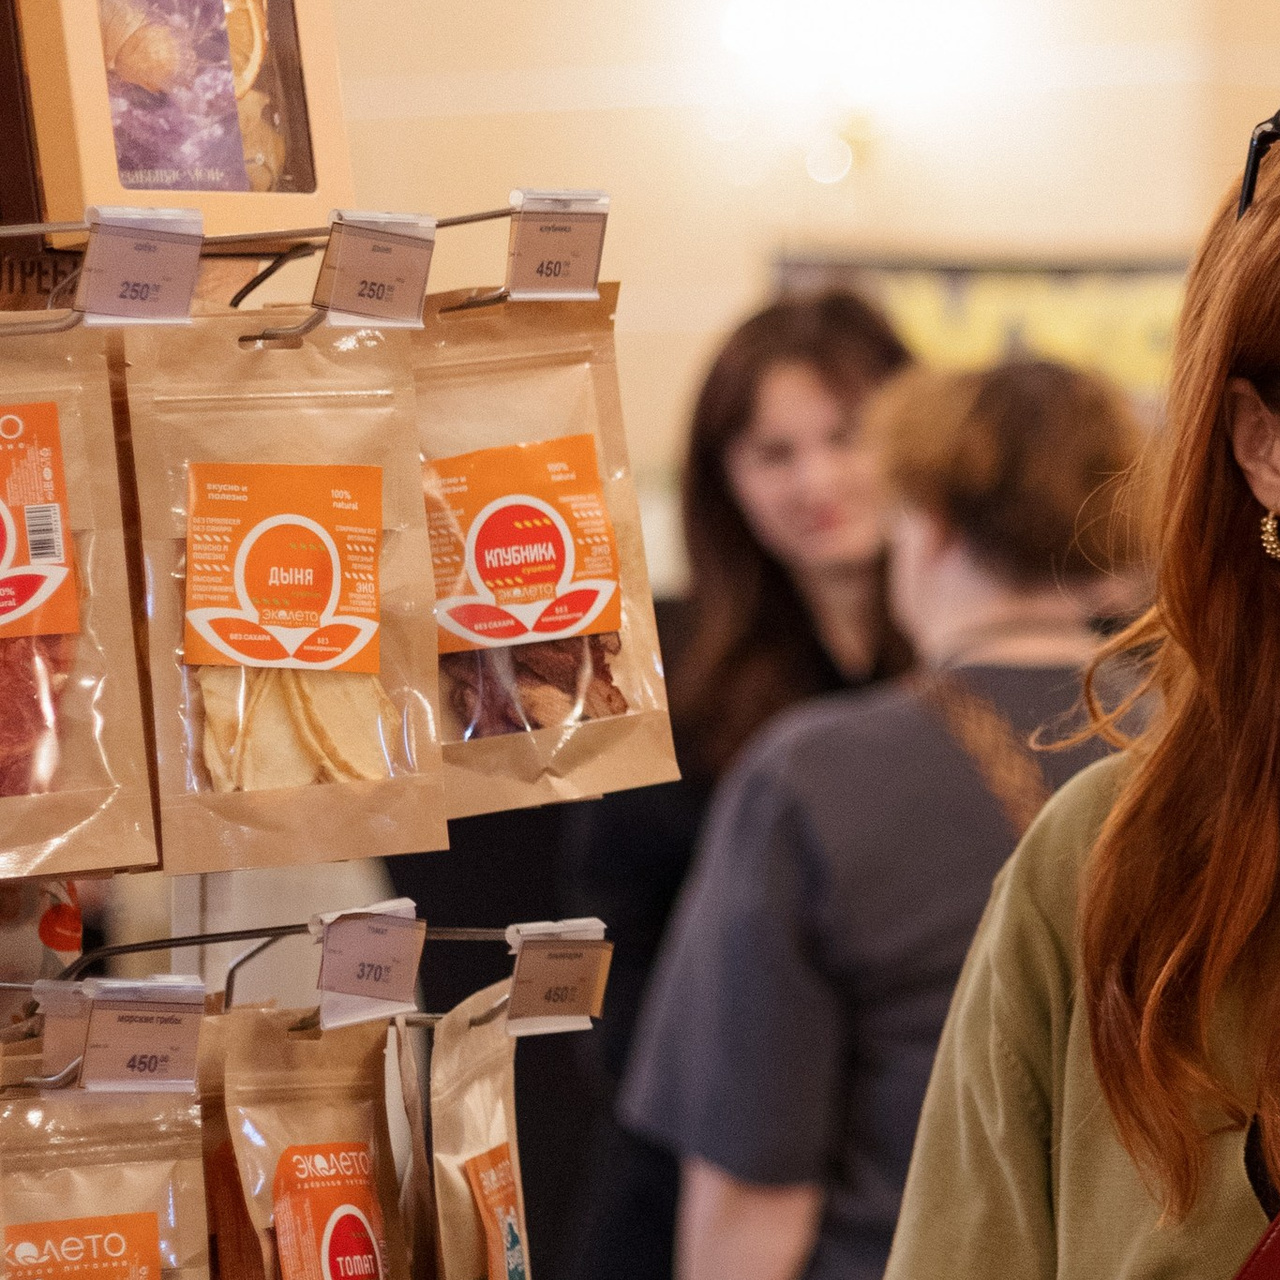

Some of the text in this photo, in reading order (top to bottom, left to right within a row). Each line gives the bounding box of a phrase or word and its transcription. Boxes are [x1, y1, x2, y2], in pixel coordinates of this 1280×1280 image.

[536, 260, 562, 277] 450
[119, 281, 149, 300] 250
[358, 280, 386, 300] 250
[484, 542, 557, 568] КЛУБНИКА
[268, 566, 314, 587] ДЫНЯ
[357, 962, 383, 982] 370
[126, 1055, 158, 1072] 450
[336, 1254, 375, 1278] ТОМАТ
